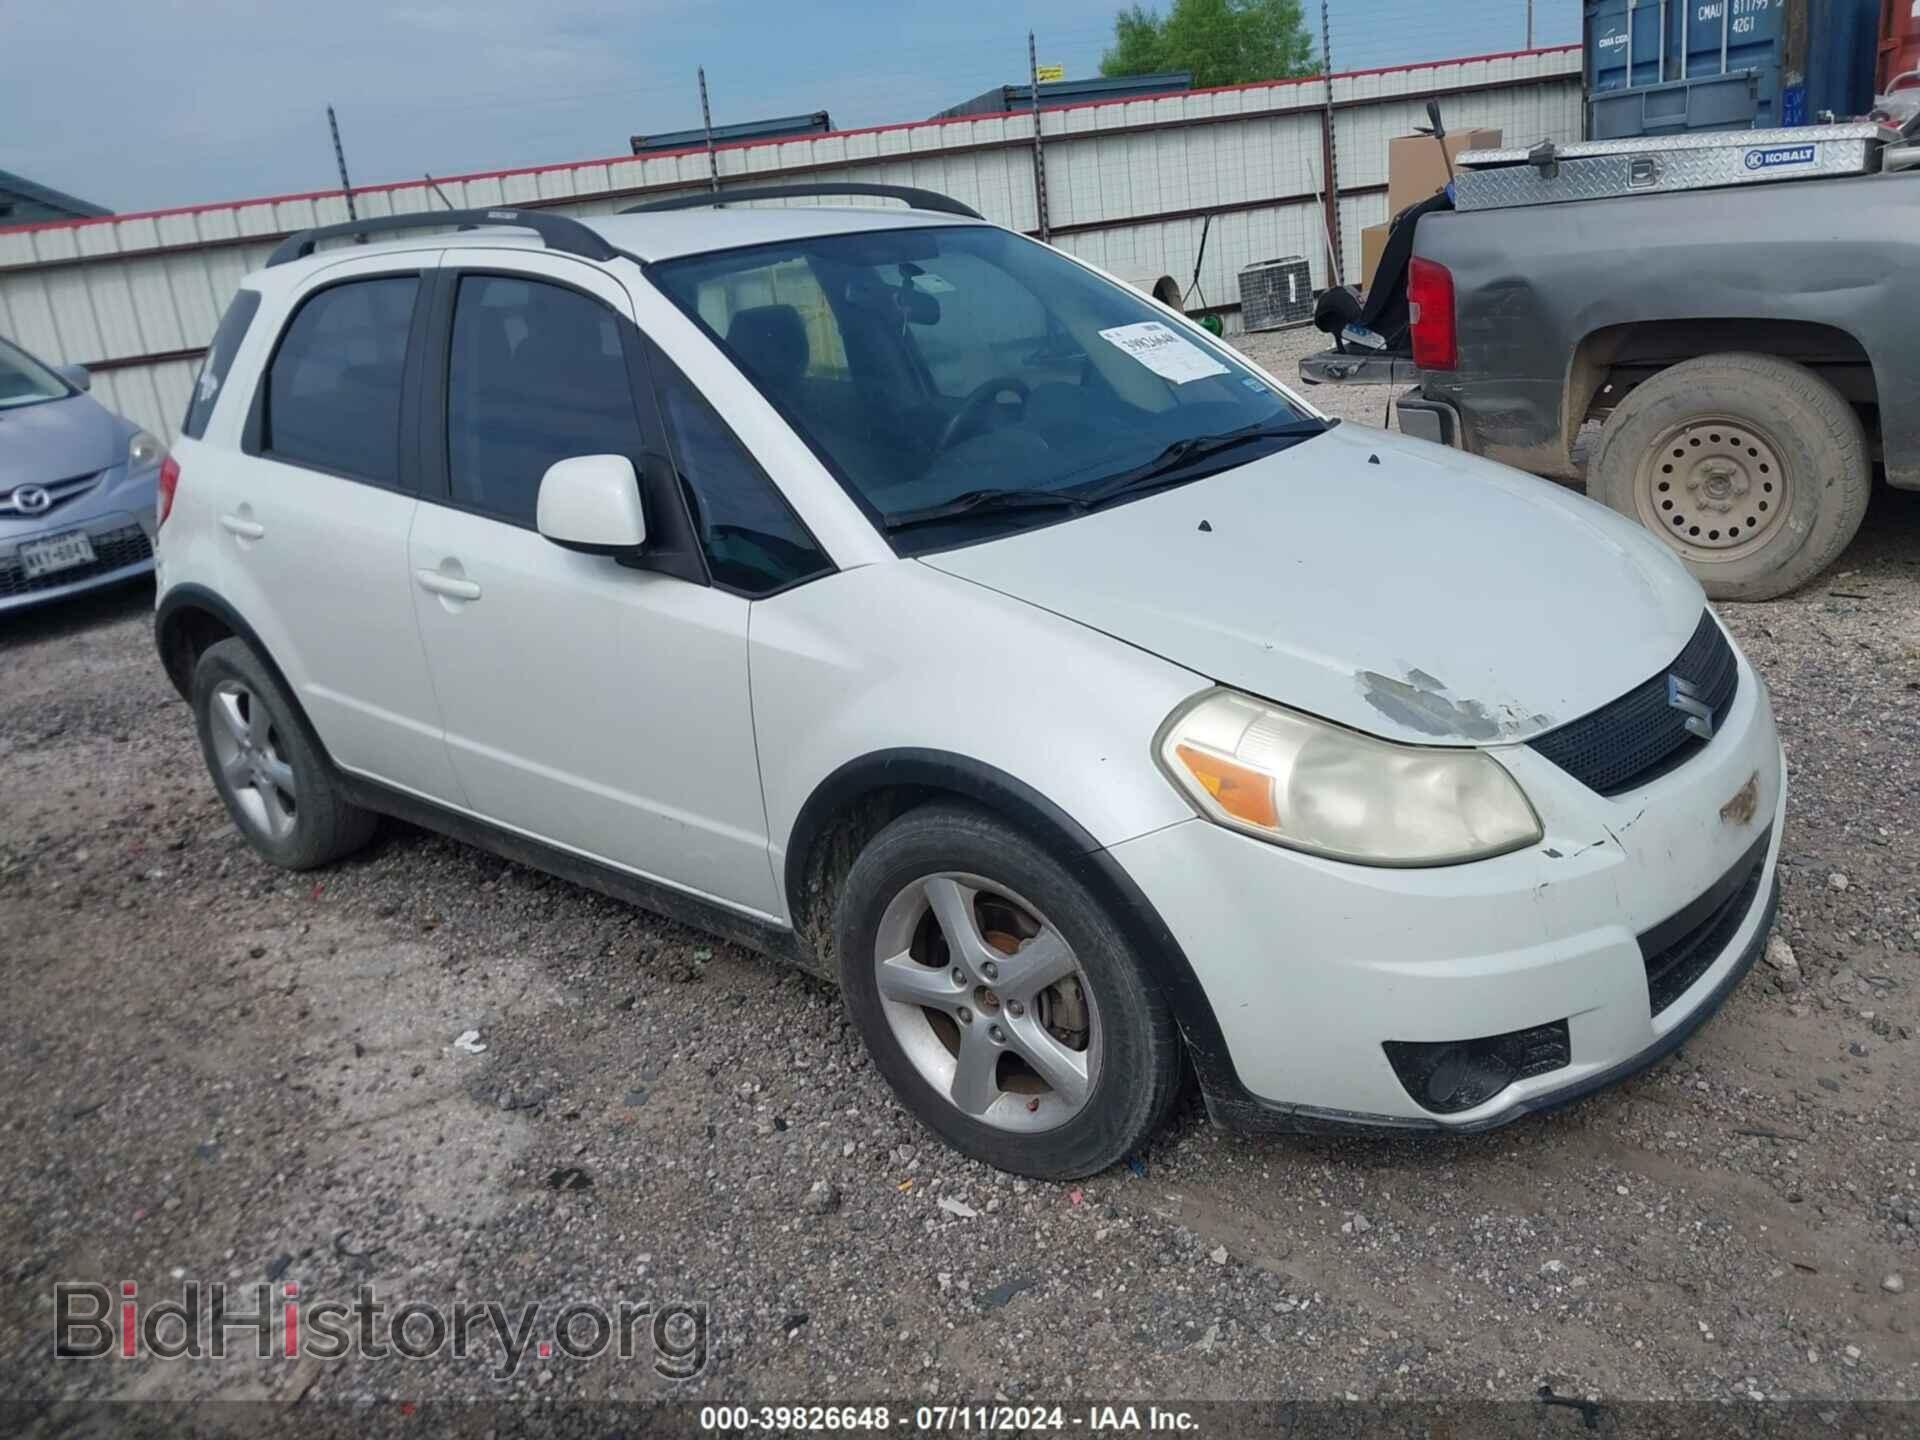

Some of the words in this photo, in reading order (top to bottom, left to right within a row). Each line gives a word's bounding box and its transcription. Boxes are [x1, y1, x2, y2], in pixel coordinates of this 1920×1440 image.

[1698, 3, 1723, 21] CMAU
[1732, 16, 1755, 33] 42G1
[1765, 149, 1813, 164] KOBALT
